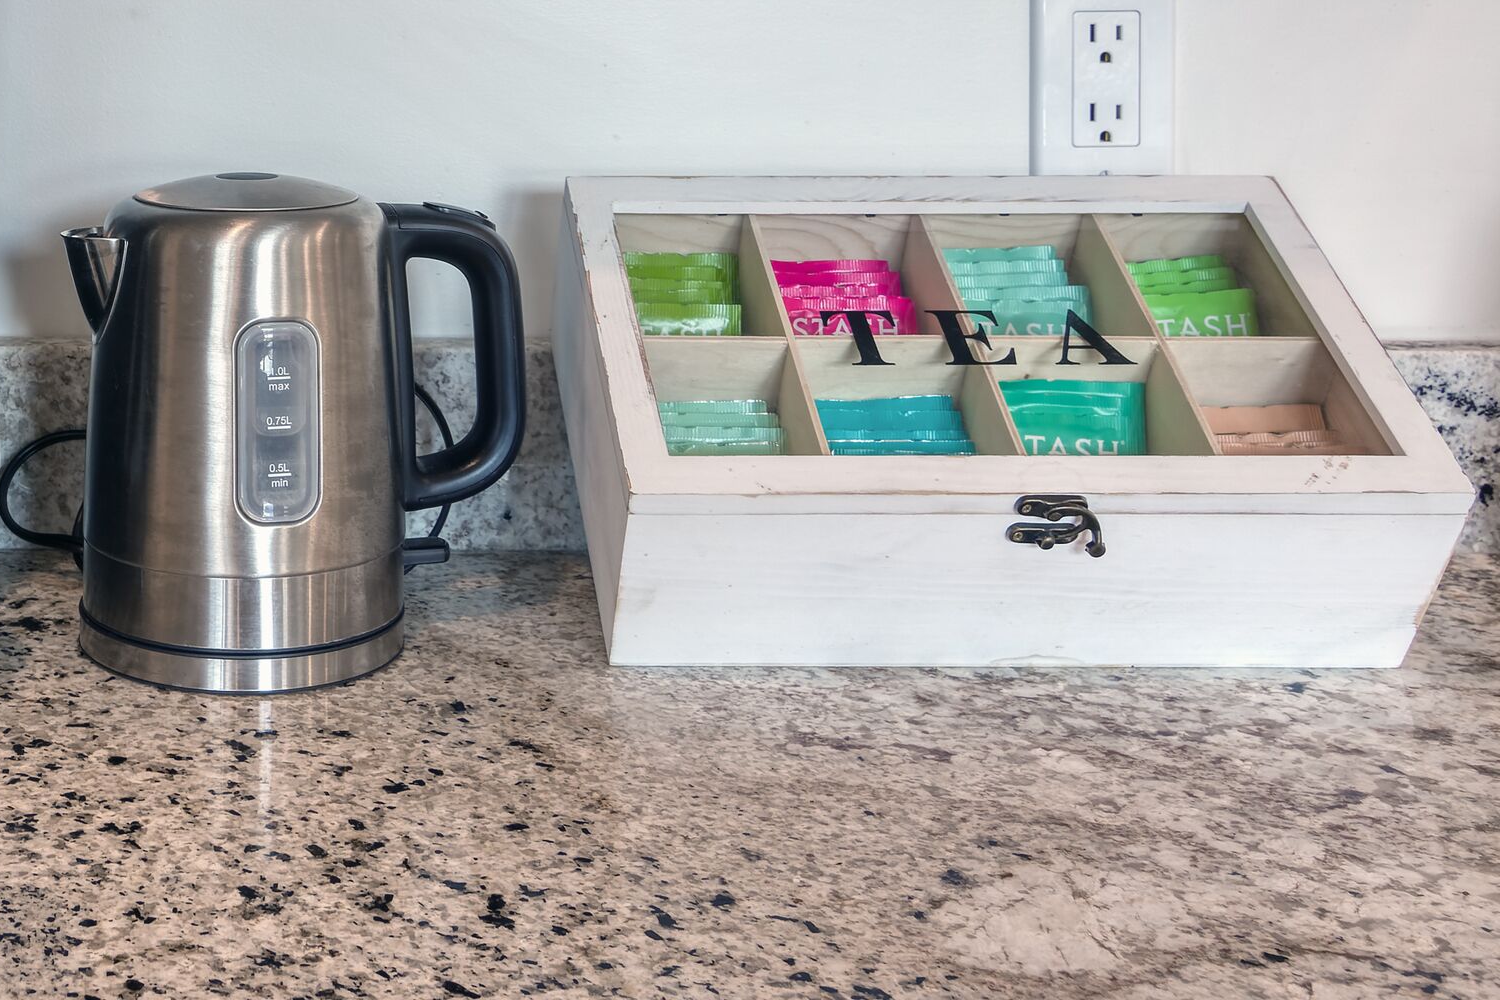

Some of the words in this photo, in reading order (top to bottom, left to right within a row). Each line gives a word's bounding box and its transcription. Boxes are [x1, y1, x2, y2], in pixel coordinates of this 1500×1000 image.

[792, 317, 900, 336] STAH
[819, 309, 1138, 366] TEA
[268, 382, 290, 391] max
[266, 416, 292, 426] 0.75L
[269, 463, 290, 473] 0.5L
[271, 478, 288, 488] min
